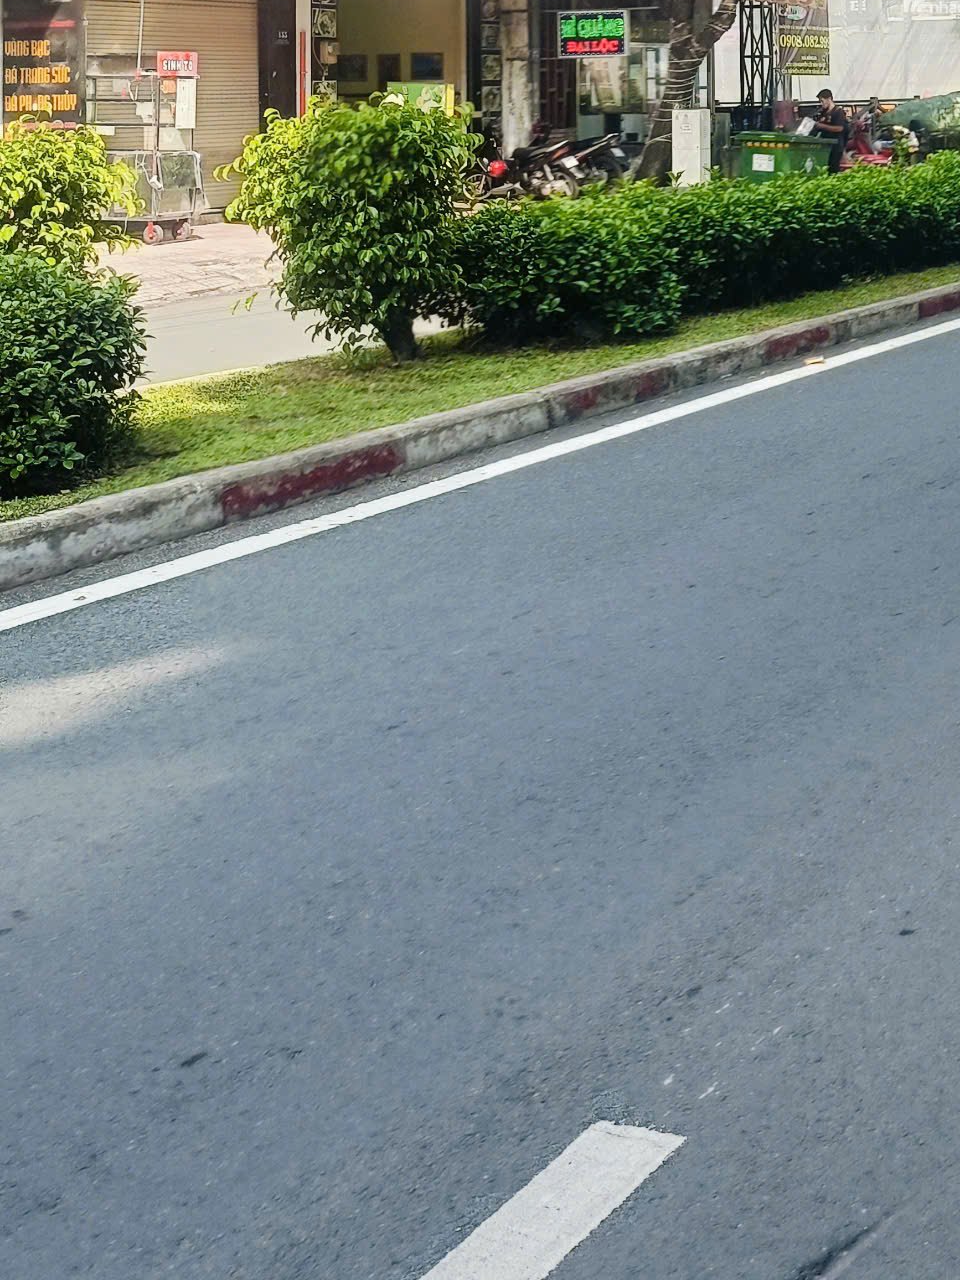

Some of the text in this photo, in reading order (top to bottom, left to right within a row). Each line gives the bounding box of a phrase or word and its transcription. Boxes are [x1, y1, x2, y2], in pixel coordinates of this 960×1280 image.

[5, 37, 51, 59] VÀNG BẠC
[20, 67, 51, 84] TRANG
[51, 64, 71, 84] SỨC
[20, 94, 51, 112] PHNG
[52, 89, 77, 111] THỦY
